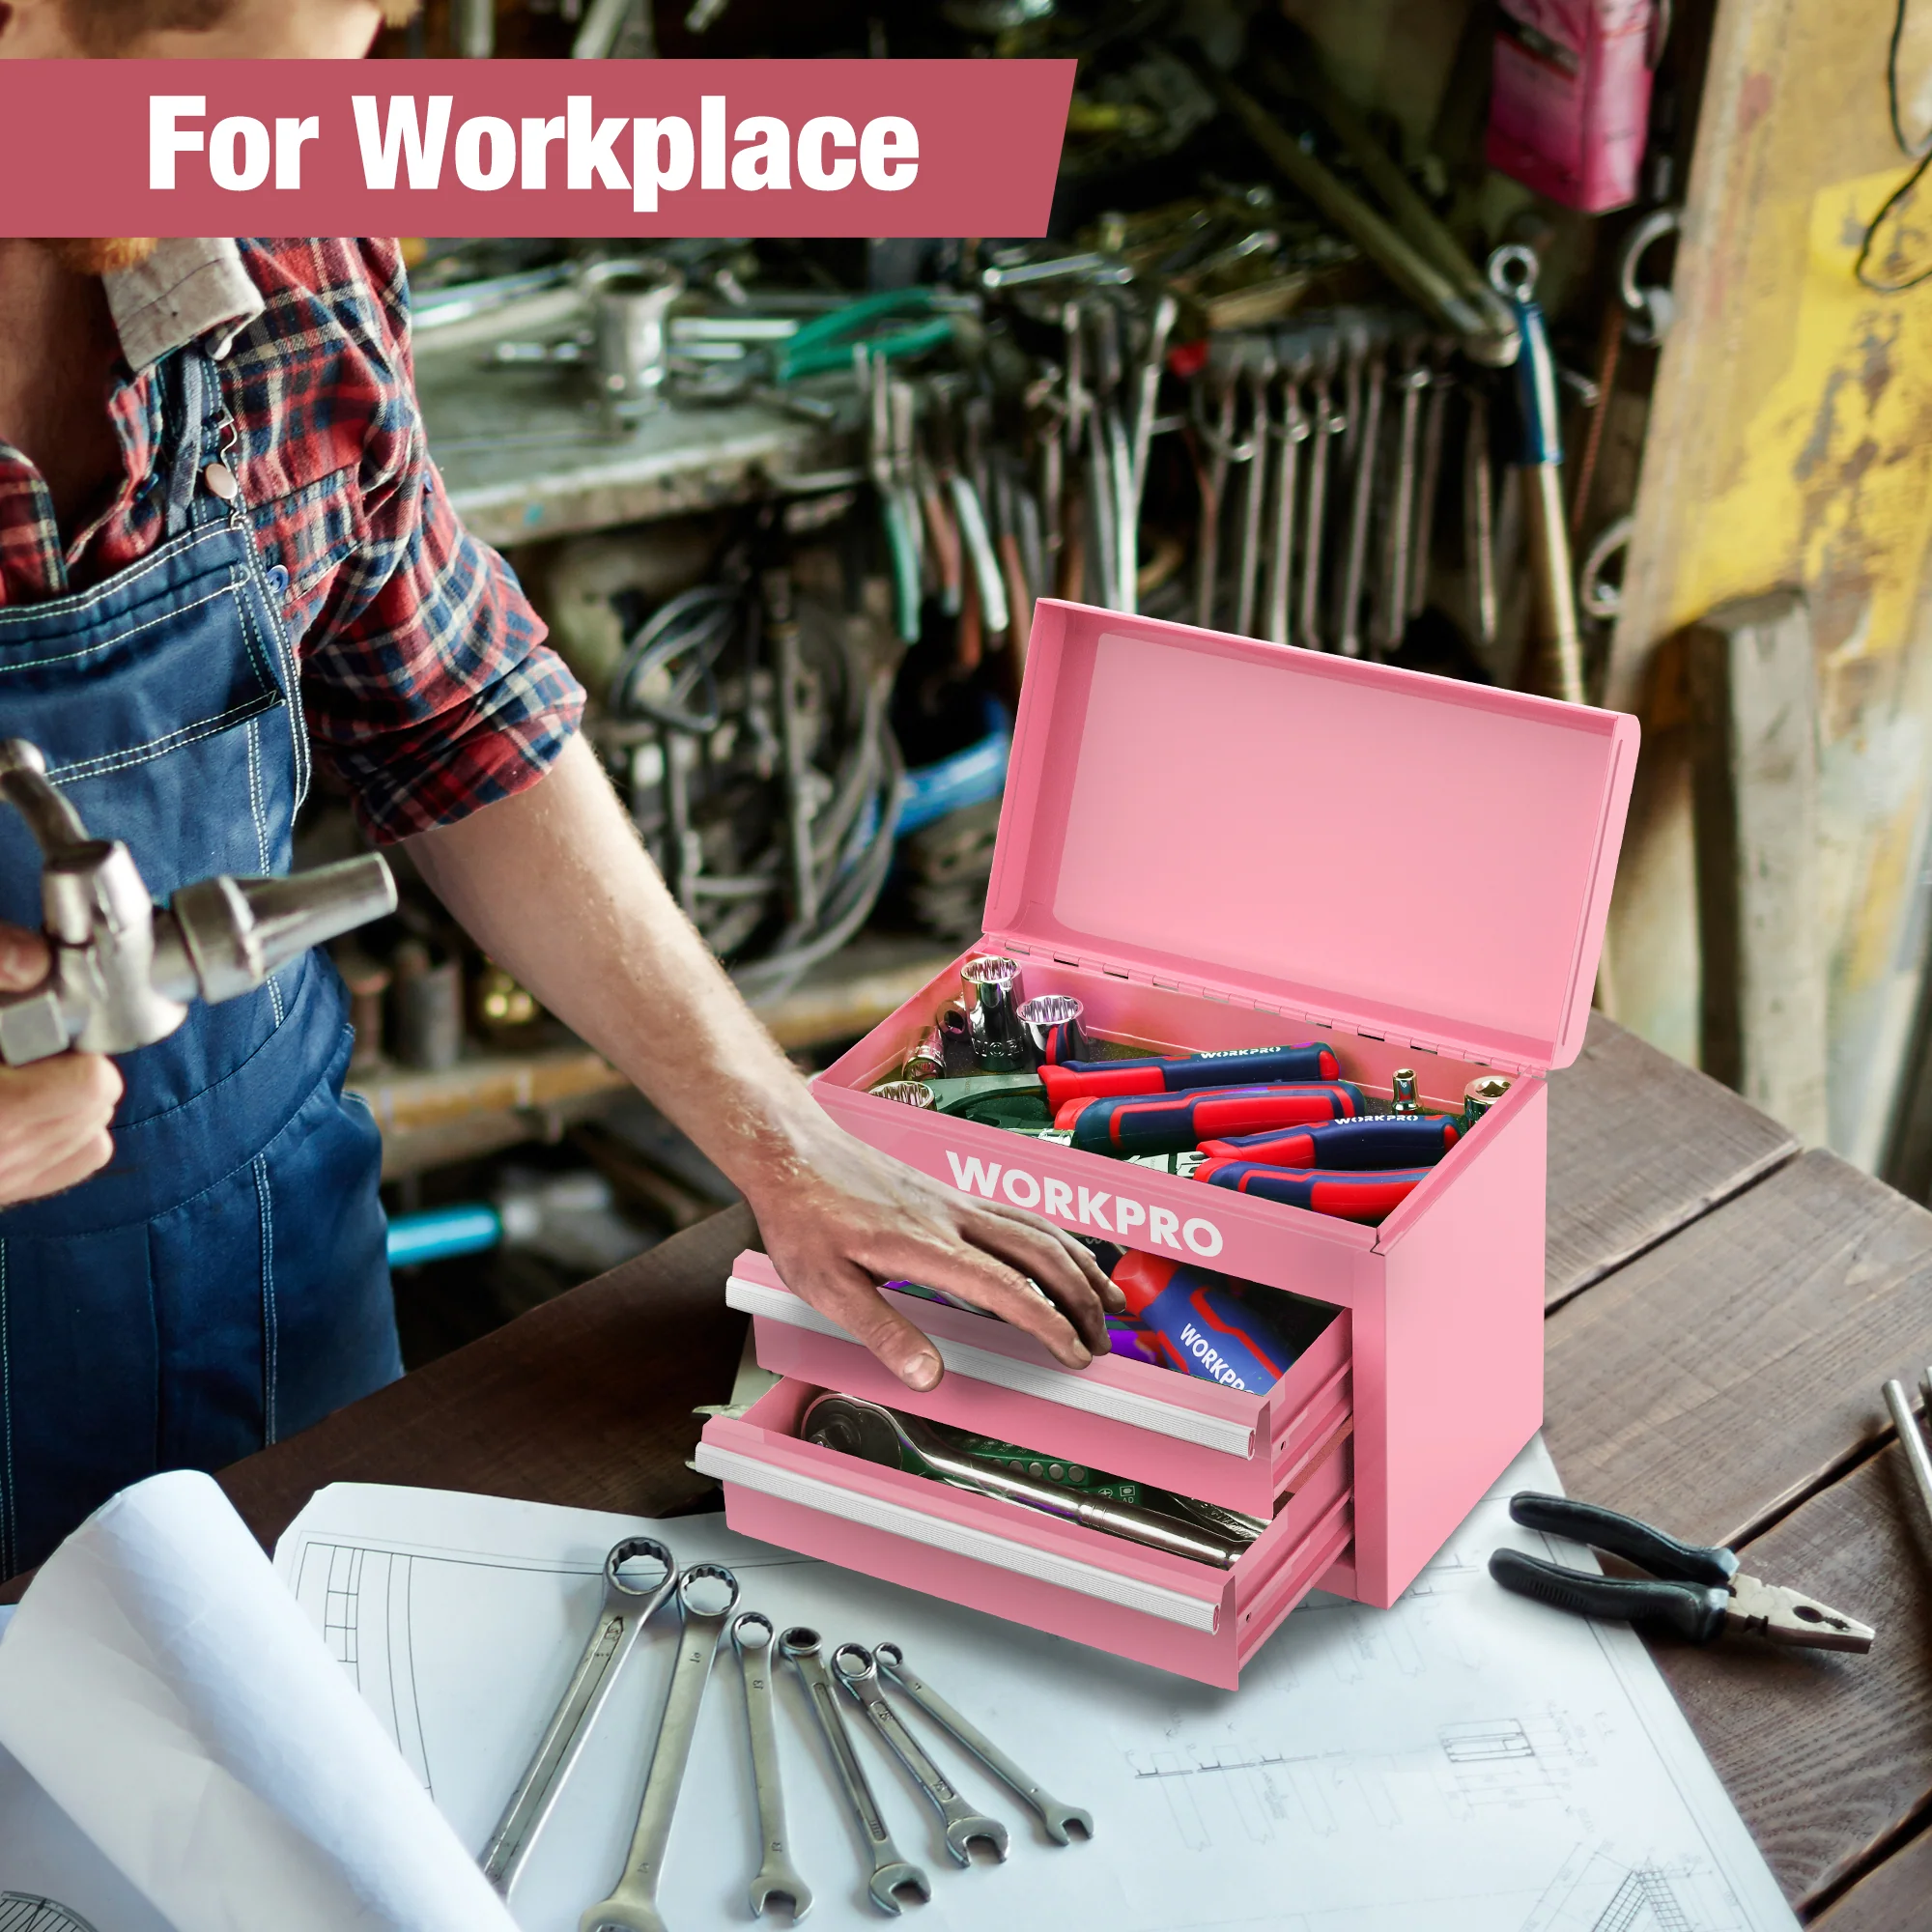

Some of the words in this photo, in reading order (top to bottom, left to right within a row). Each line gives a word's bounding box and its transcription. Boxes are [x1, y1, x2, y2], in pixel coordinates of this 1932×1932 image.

[1201, 1046, 1282, 1059] WORKPRO
[1334, 1114, 1419, 1125] WORKPRO
[946, 1150, 1224, 1258] WORKPRO
[1179, 1322, 1255, 1394] WORKPR
